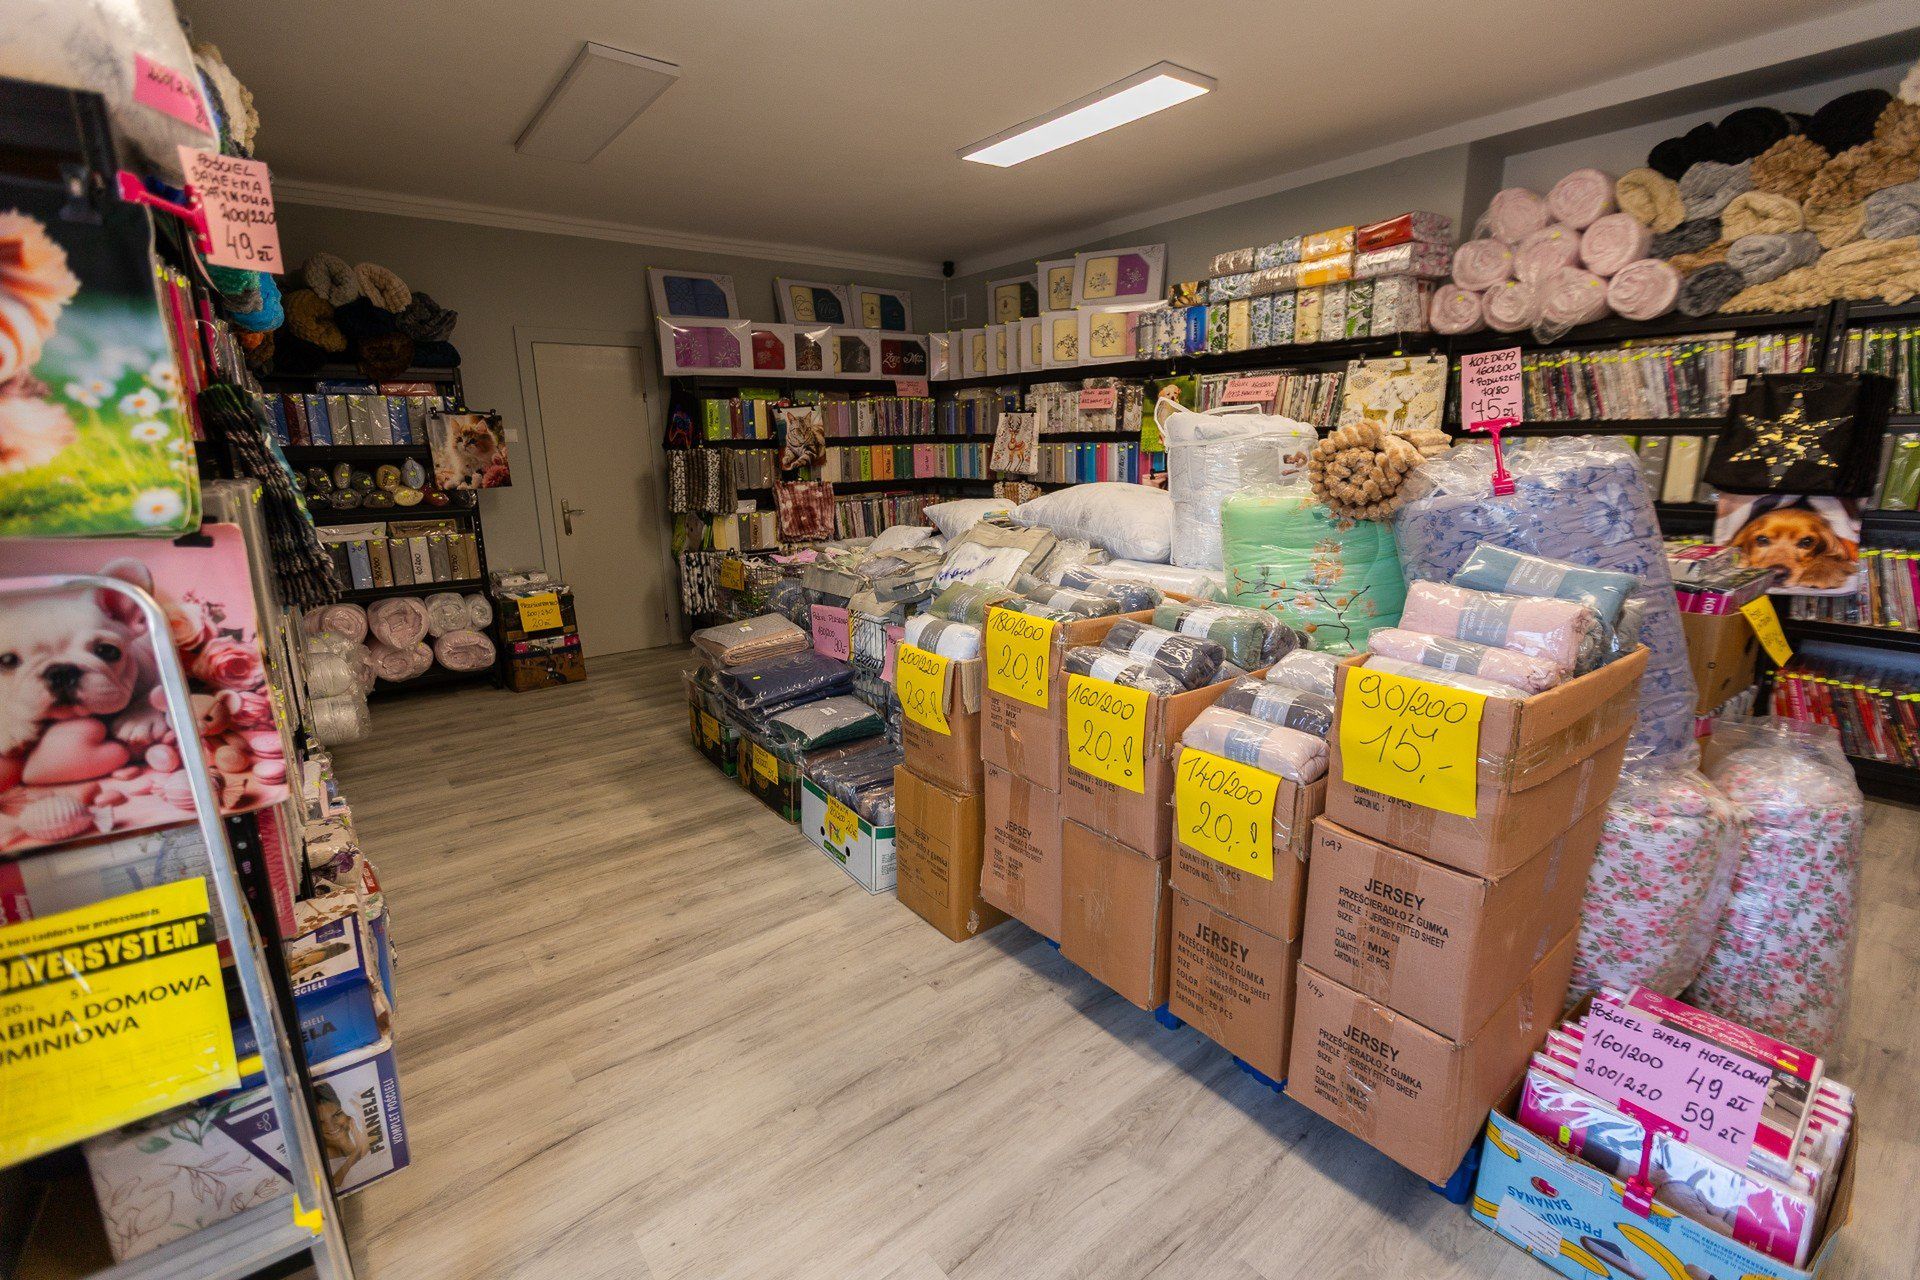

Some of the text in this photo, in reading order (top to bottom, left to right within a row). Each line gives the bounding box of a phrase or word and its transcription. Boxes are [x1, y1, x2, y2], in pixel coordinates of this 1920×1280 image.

[225, 225, 253, 260] 49
[1476, 362, 1517, 376] 160/200
[1471, 397, 1502, 421] 75
[990, 611, 1044, 641] 180/200
[900, 648, 940, 676] 200/220
[1068, 683, 1135, 720] 160/200
[1359, 674, 1468, 724] 90/200
[1183, 757, 1263, 805] 140/200
[1353, 794, 1371, 809] CARTON
[1005, 820, 1032, 839] JERSEY
[1179, 861, 1200, 878] CARTON
[1339, 886, 1449, 938] PRZEŚCIERADŁO Z GUMKA
[1364, 878, 1425, 911] JERSEY
[1337, 910, 1354, 924] SIZE
[1338, 898, 1445, 949] ARTICLE JERSEY FITTED SHEET
[1196, 923, 1249, 963] JERSEY
[1334, 938, 1359, 954] QUANTITY
[1376, 956, 1390, 970] PCS
[1335, 927, 1390, 958] COLOR MIX
[1177, 945, 1204, 966] ARTICLE
[1229, 975, 1249, 992] FITTED
[1250, 986, 1271, 1002] SHEET
[1177, 968, 1198, 987] COLOR
[1177, 956, 1191, 969] SIZE
[1238, 993, 1252, 1006] CM
[1236, 965, 1265, 987] GUMKA
[84, 974, 212, 1020] DOMOWA
[1176, 980, 1204, 1003] QUANTITY
[1220, 1003, 1234, 1020] PCS
[1317, 1050, 1332, 1064] SIZE
[1319, 1028, 1422, 1090] PRZEŚCIERADŁO Z GUMKA
[1343, 1024, 1400, 1062] JERSEY
[1652, 1028, 1691, 1053] BIAŁA
[1697, 1047, 1771, 1089] HOTELOWA
[1315, 1065, 1336, 1081] COLOR
[1318, 1040, 1419, 1100] ARTICLE JERSEY FITTED SHEET
[1592, 1029, 1663, 1070] 160/200
[1686, 1067, 1725, 1100] 49
[383, 1077, 404, 1145] KOMPLET POŚCIELI
[1315, 1076, 1340, 1093] QUANTITY
[1353, 1098, 1368, 1112] PCS
[1584, 1058, 1663, 1102] 200/220
[1681, 1101, 1716, 1132] 59
[360, 1085, 386, 1155] FLANELA
[1507, 1185, 1574, 1212] BANANAS
